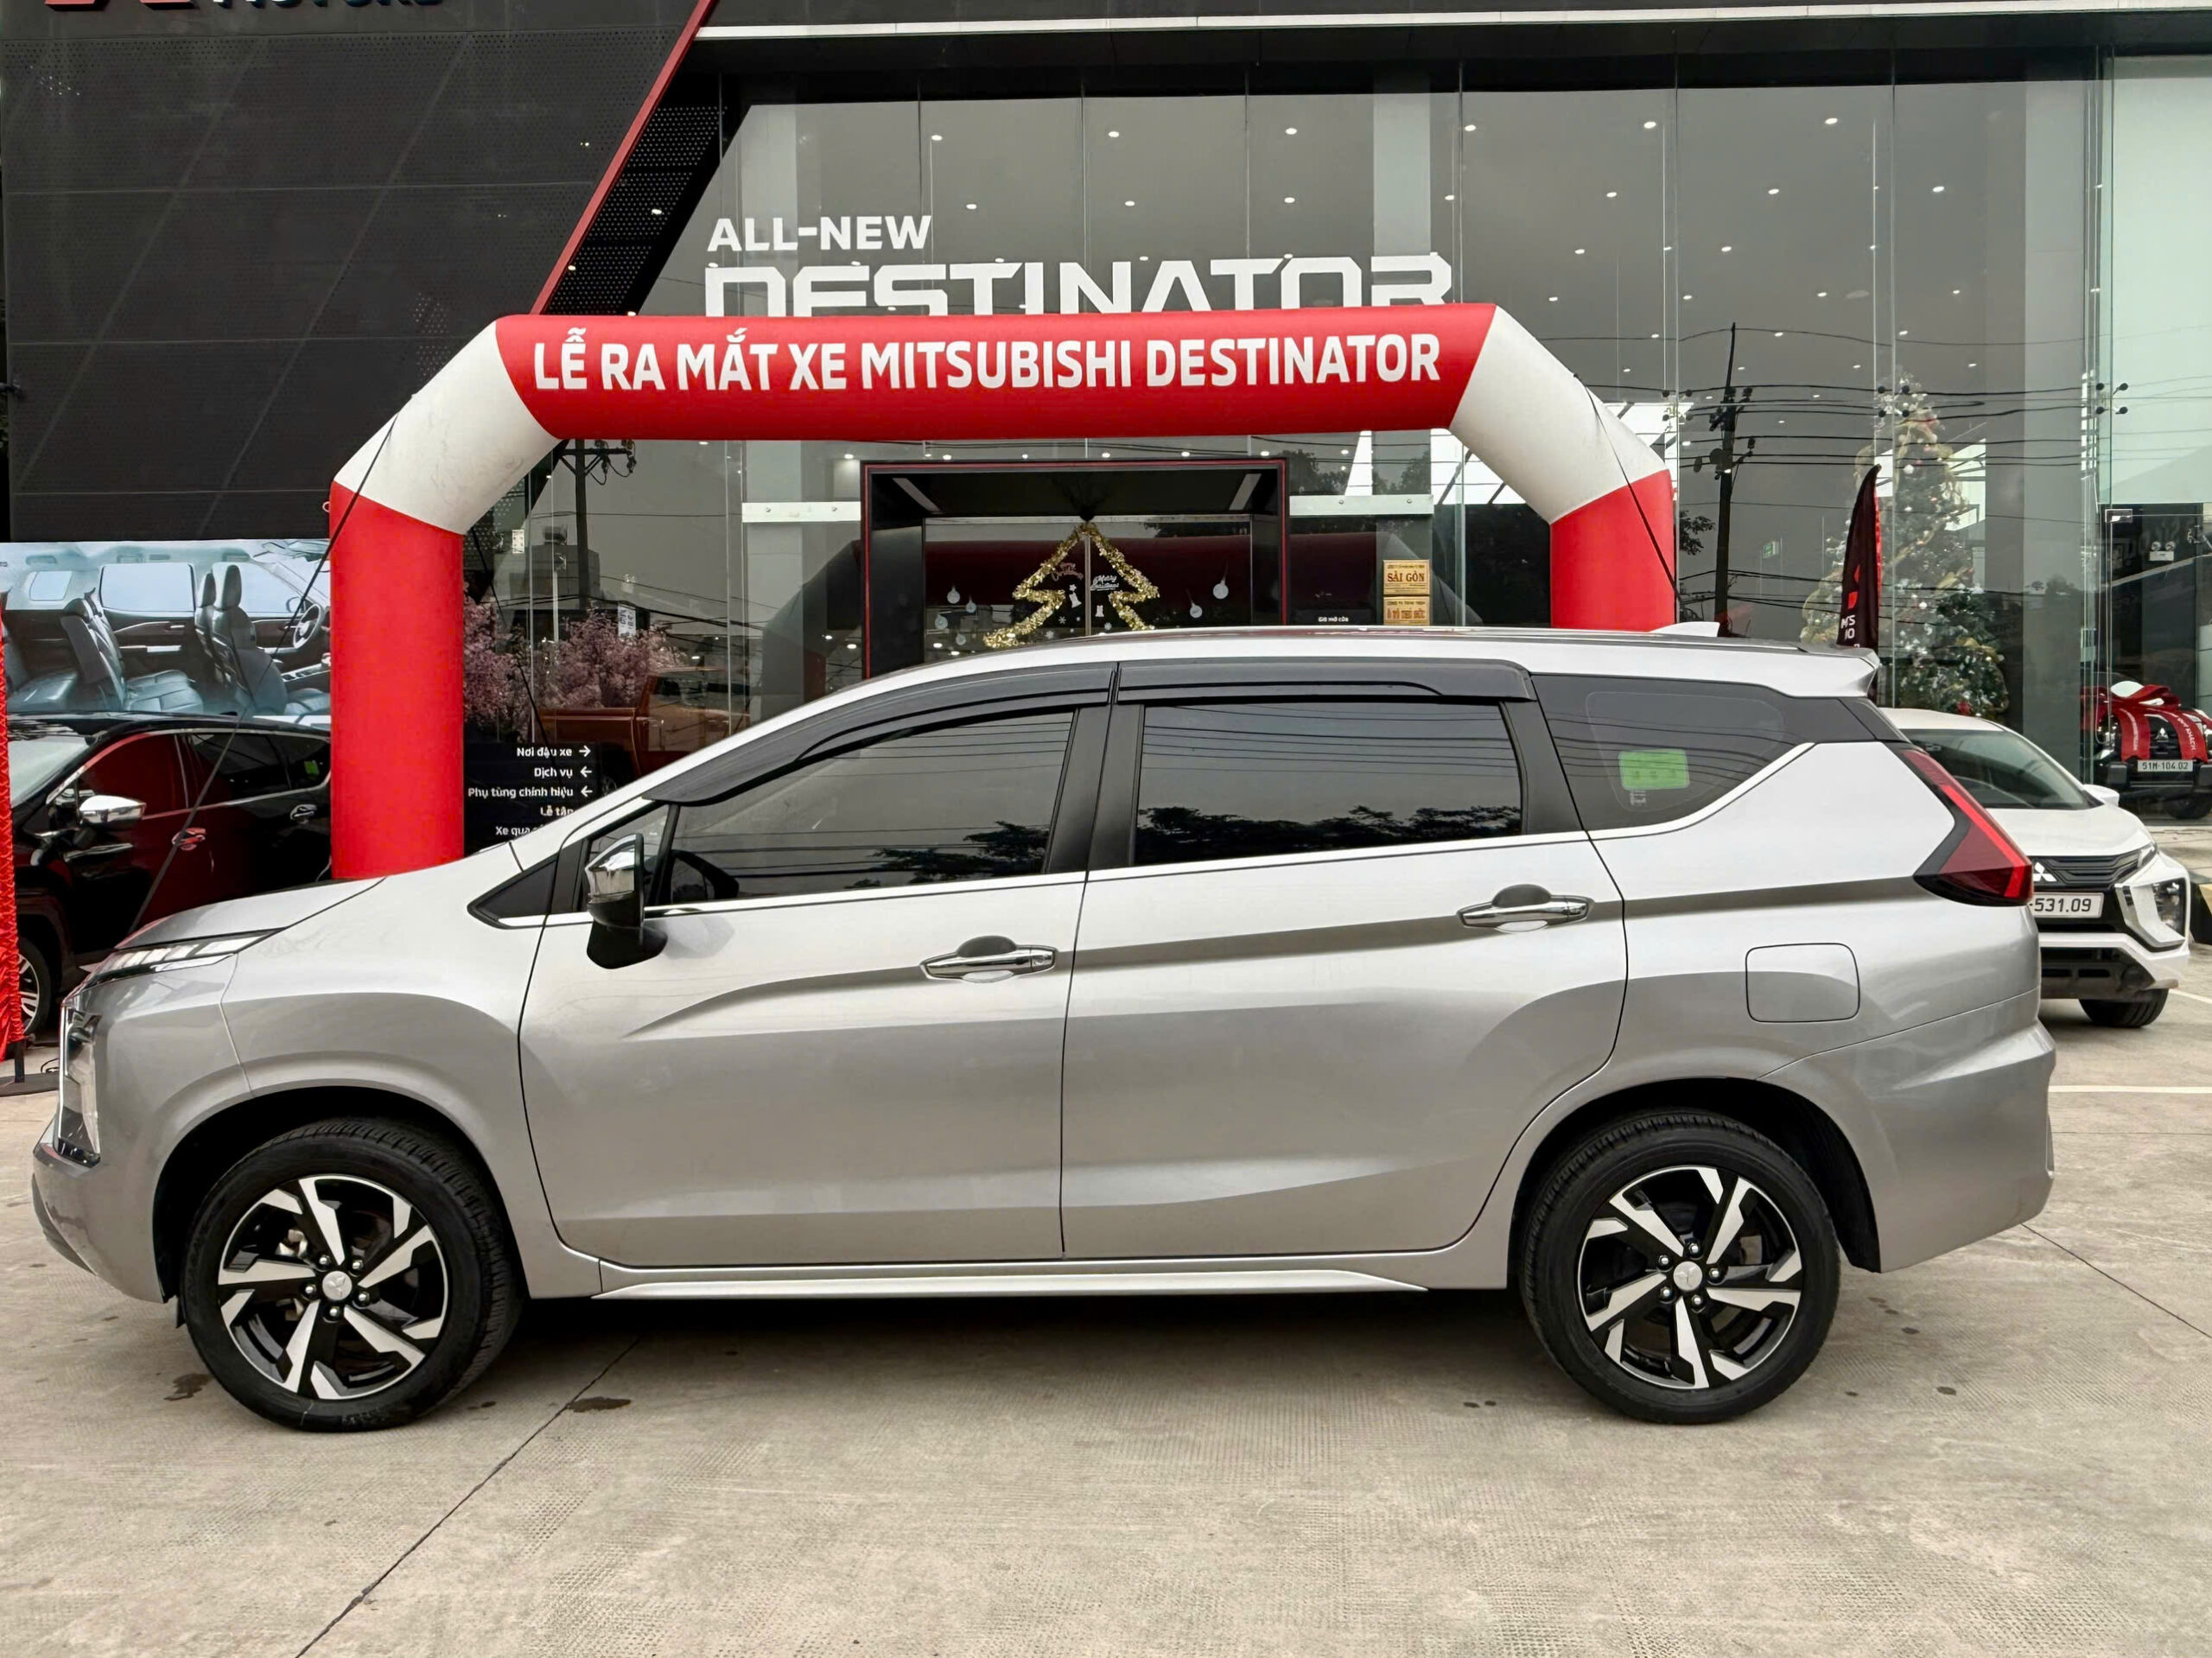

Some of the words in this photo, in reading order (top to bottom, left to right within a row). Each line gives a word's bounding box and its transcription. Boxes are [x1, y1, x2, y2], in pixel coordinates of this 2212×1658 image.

[707, 215, 932, 251] ALL-NEW
[704, 254, 1453, 317] DESTINATOR
[534, 327, 588, 390] LỄ
[601, 344, 666, 391] RA
[677, 327, 779, 391] MẮT
[787, 343, 848, 390] XE
[861, 340, 1131, 390] MITSUBISHI
[1146, 334, 1441, 387] DESTINATOR
[1387, 571, 1403, 582] SÀI
[1406, 571, 1425, 582] GÒN
[517, 746, 535, 757] Nơi
[559, 748, 573, 757] xe
[534, 766, 557, 778] Dịch
[560, 768, 574, 778] vụ
[467, 787, 489, 799] Phụ
[491, 787, 517, 799] tùng
[518, 786, 548, 797] chính
[495, 826, 509, 835] Xe
